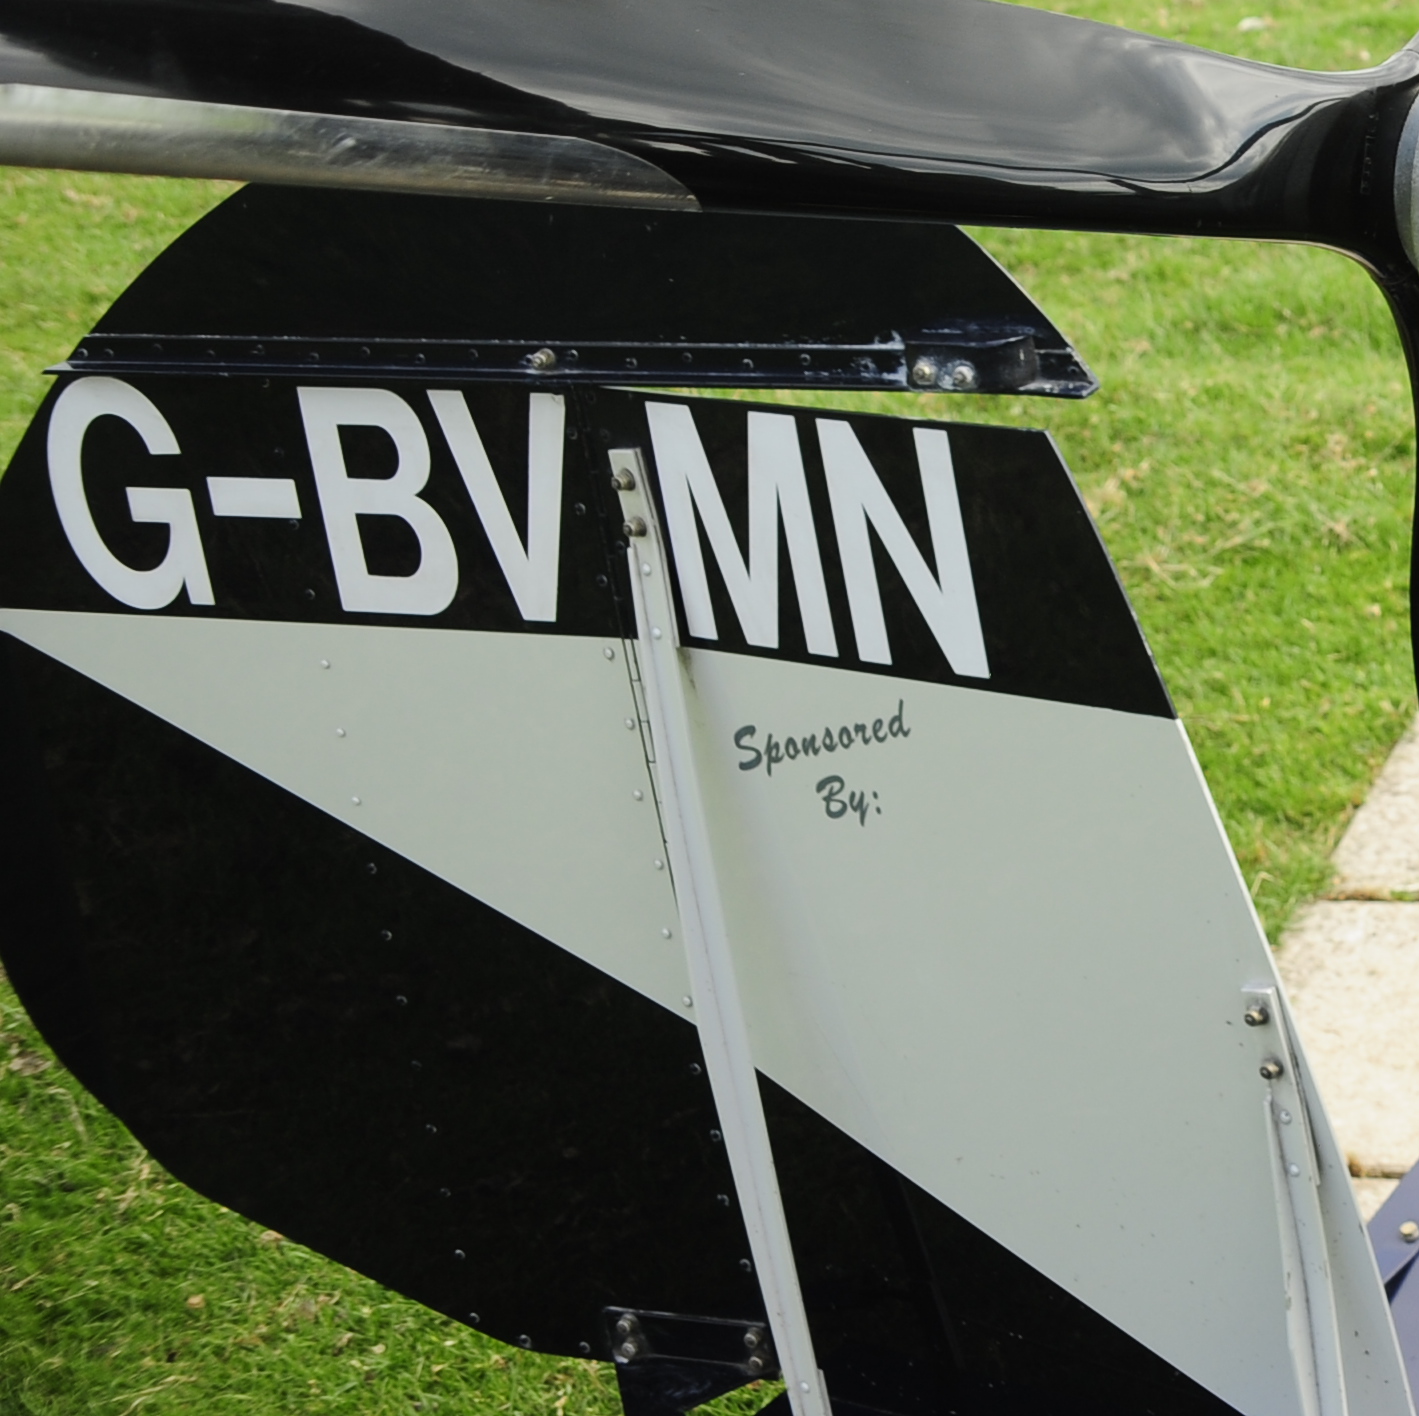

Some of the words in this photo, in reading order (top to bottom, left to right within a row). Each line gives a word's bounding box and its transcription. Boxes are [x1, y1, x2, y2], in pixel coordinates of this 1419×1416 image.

[46, 375, 566, 623] G-BV
[645, 401, 990, 679] MN
[733, 700, 911, 777] Sponsored
[814, 774, 883, 826] By:
